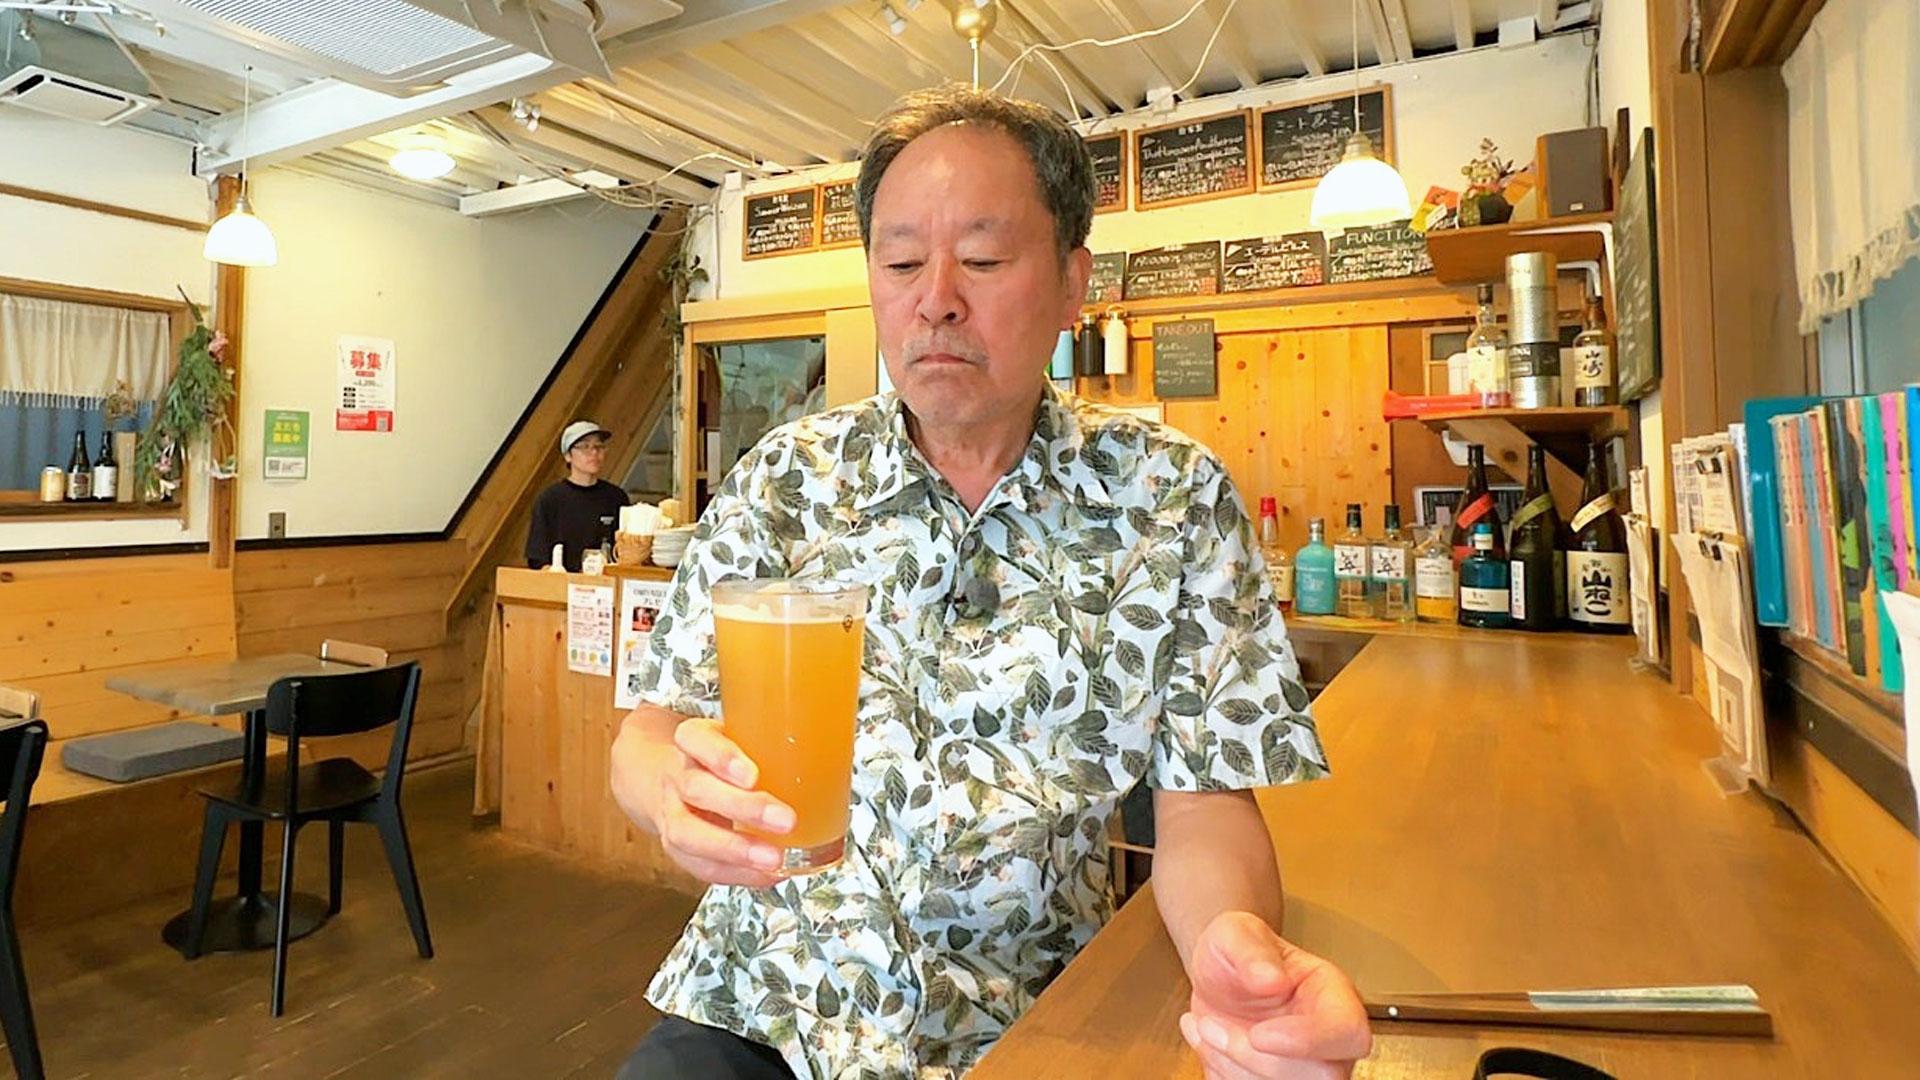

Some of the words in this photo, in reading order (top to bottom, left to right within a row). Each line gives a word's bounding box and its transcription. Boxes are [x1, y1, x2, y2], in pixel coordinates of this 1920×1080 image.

[1347, 228, 1424, 245] FUNCTION
[350, 350, 382, 371] 募集
[1582, 569, 1612, 616] 山ねこ
